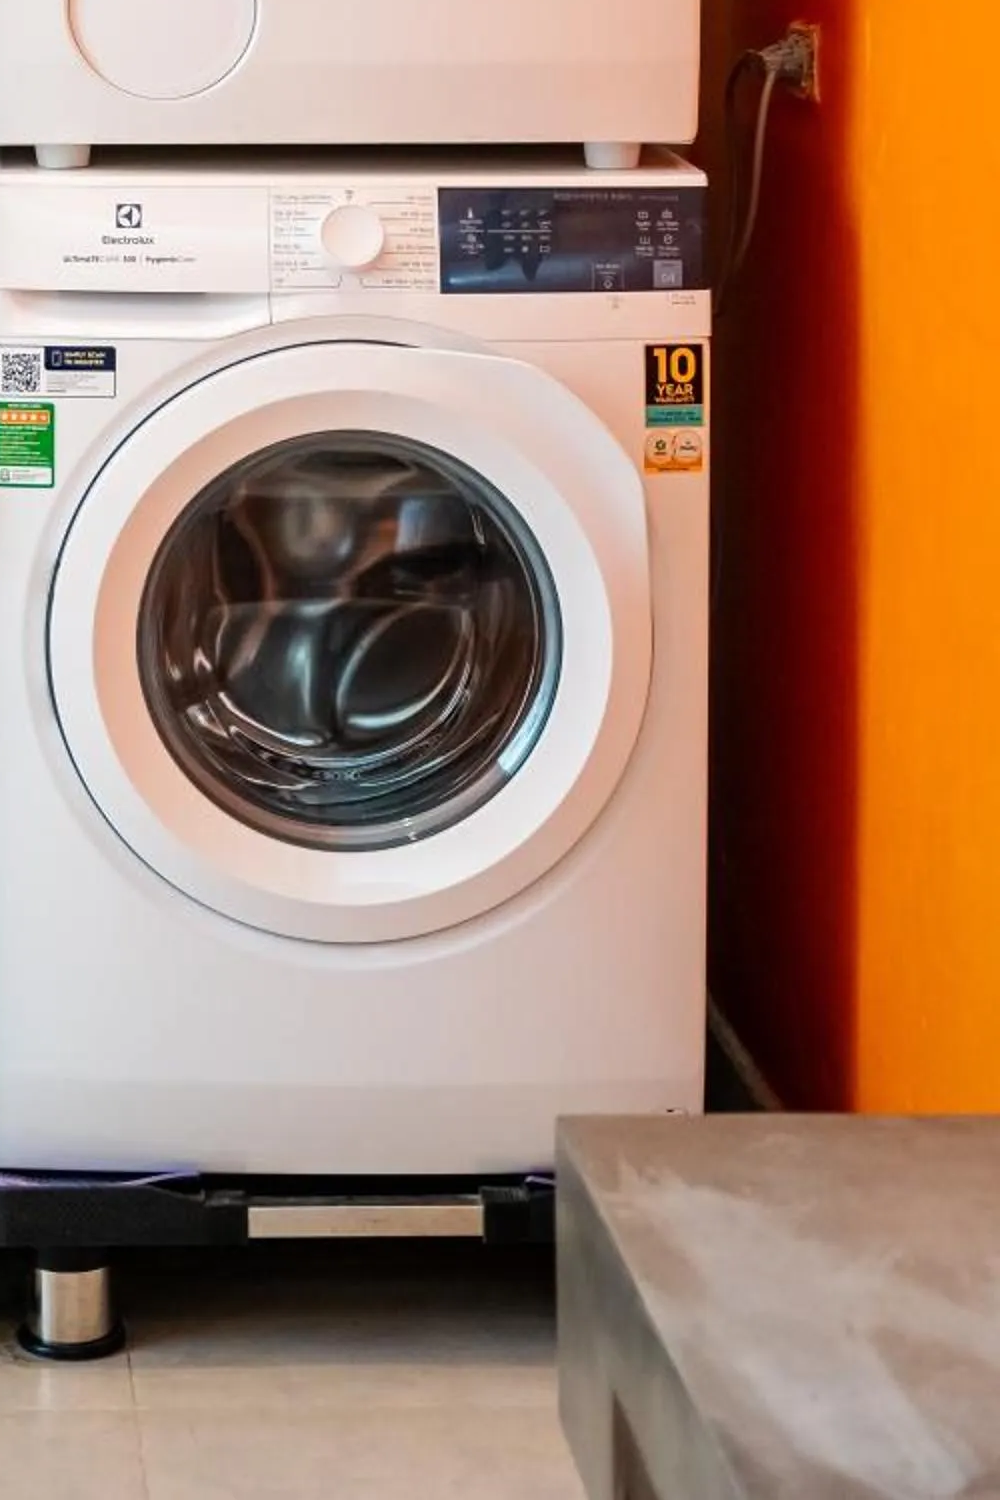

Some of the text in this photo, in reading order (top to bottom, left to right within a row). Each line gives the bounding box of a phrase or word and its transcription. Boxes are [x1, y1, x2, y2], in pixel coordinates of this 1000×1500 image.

[101, 235, 155, 245] Electrolux
[653, 347, 696, 383] 10
[656, 383, 693, 396] YEAR
